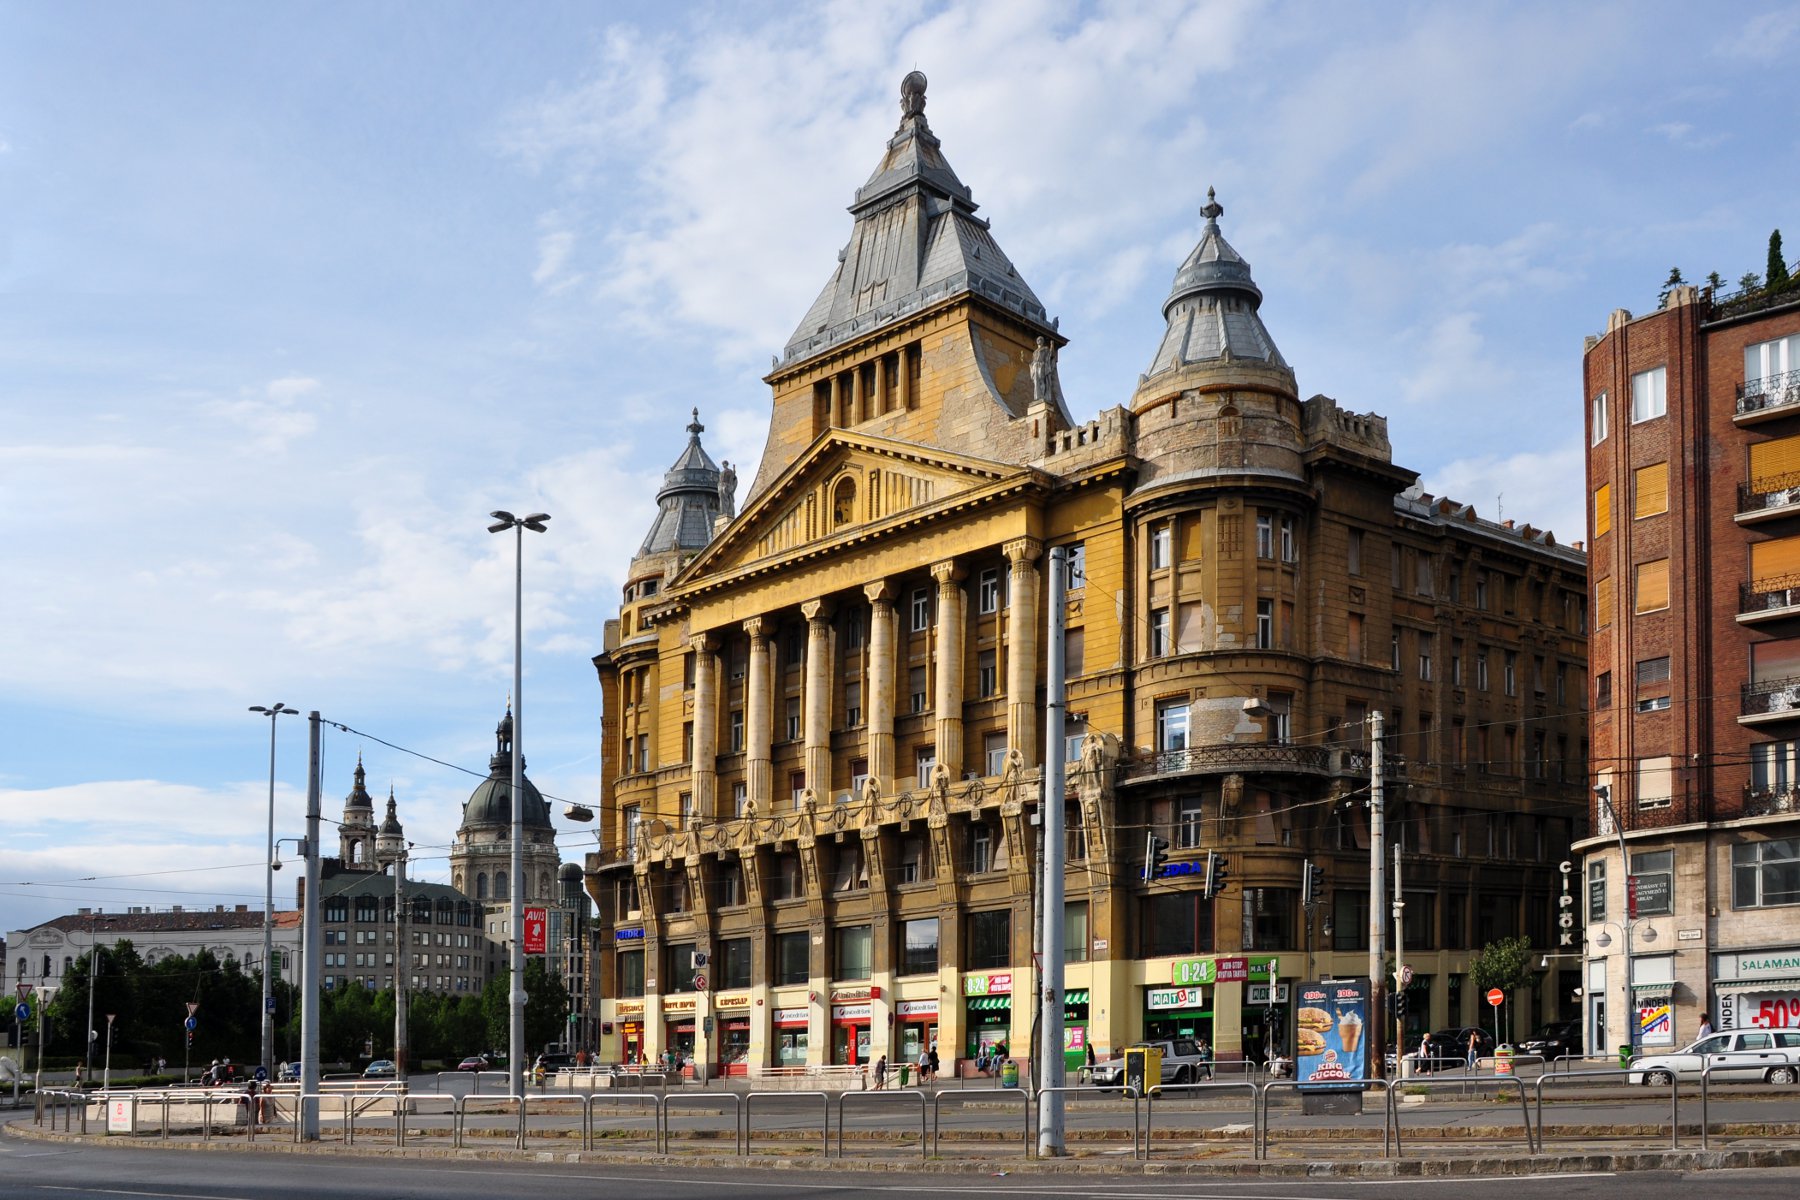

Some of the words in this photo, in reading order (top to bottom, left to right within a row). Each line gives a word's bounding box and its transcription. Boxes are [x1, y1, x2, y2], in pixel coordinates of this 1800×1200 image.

[526, 911, 545, 922] AVIS
[1181, 962, 1208, 982] 0-24
[1153, 989, 1196, 1005] MATCH
[1637, 999, 1668, 1009] MINDEN
[1317, 1062, 1343, 1071] KING
[1308, 1070, 1352, 1081] CUCCOK
